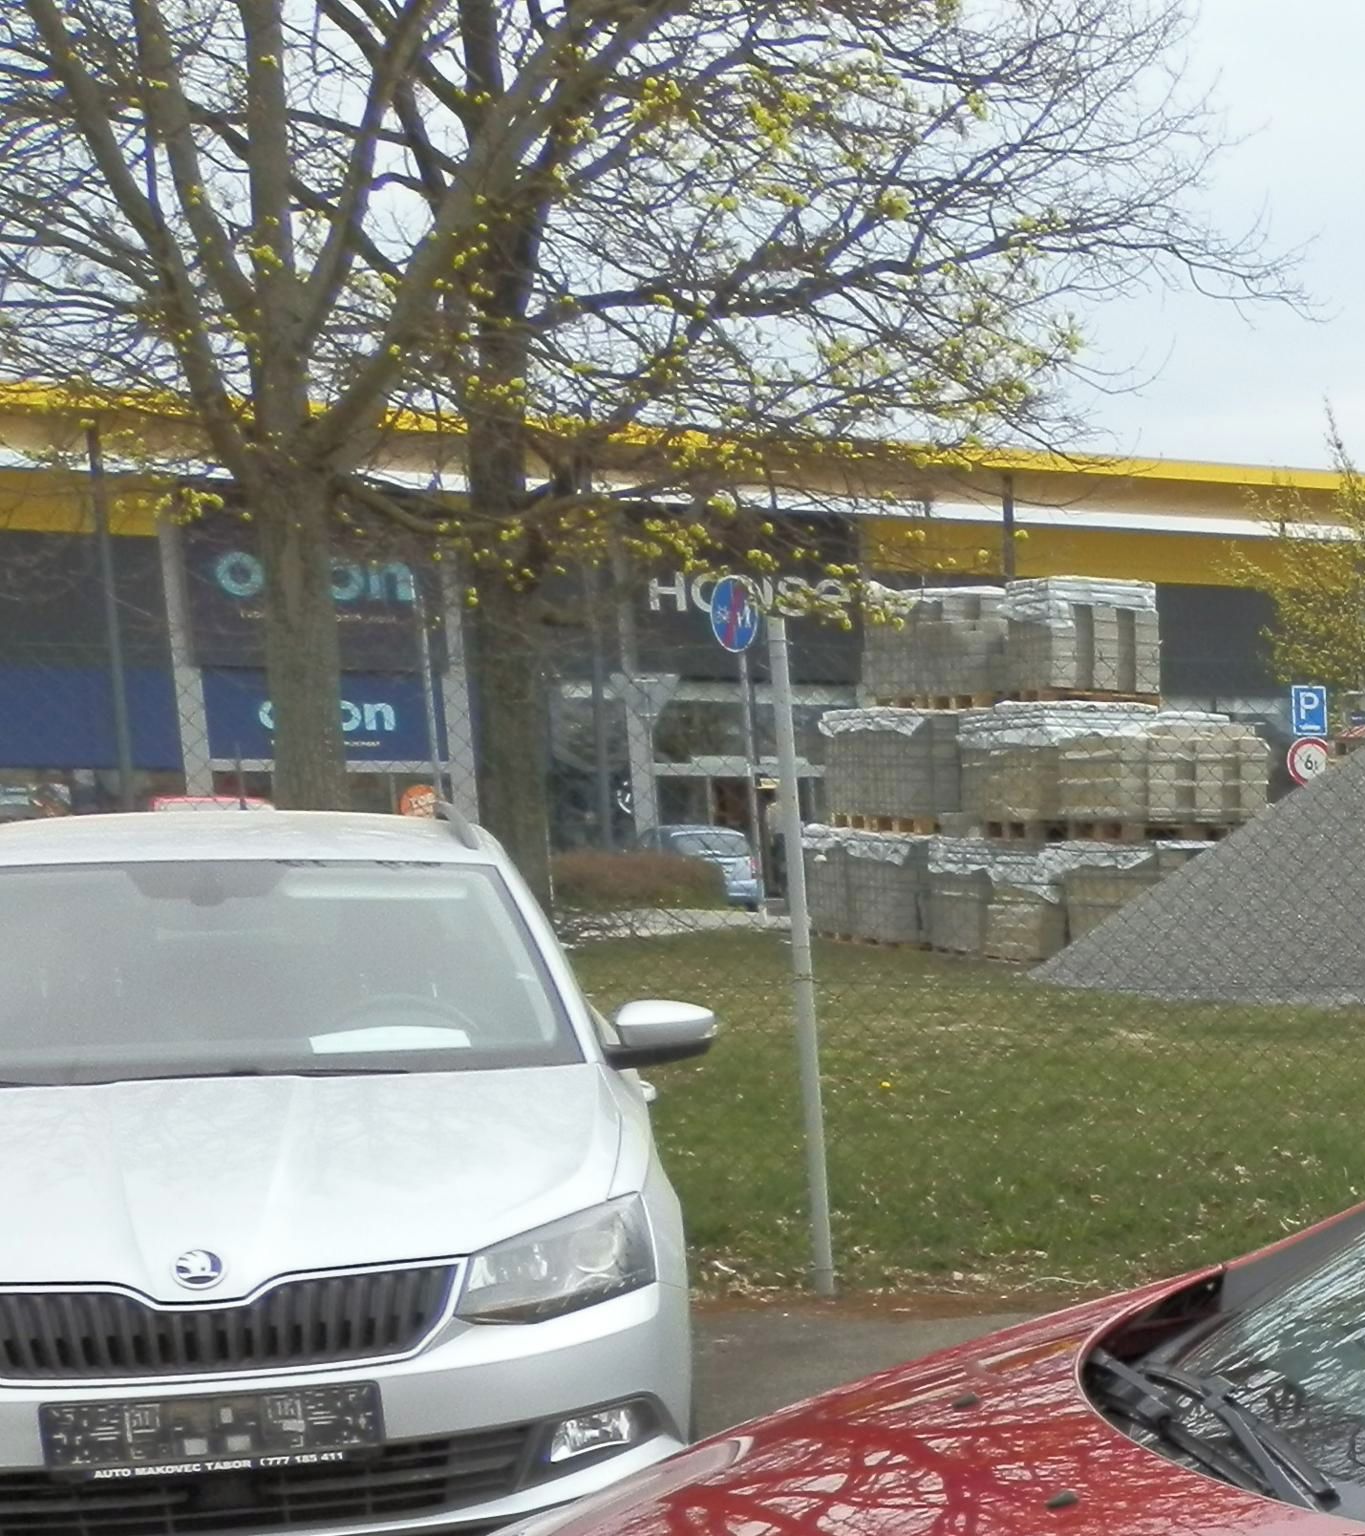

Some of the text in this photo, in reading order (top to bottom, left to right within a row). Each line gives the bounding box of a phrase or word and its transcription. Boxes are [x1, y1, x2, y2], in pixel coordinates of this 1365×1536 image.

[216, 551, 416, 601] oon
[1299, 691, 1320, 720] P
[94, 1468, 131, 1479] AUTO
[135, 1463, 201, 1476] MAKOVEC
